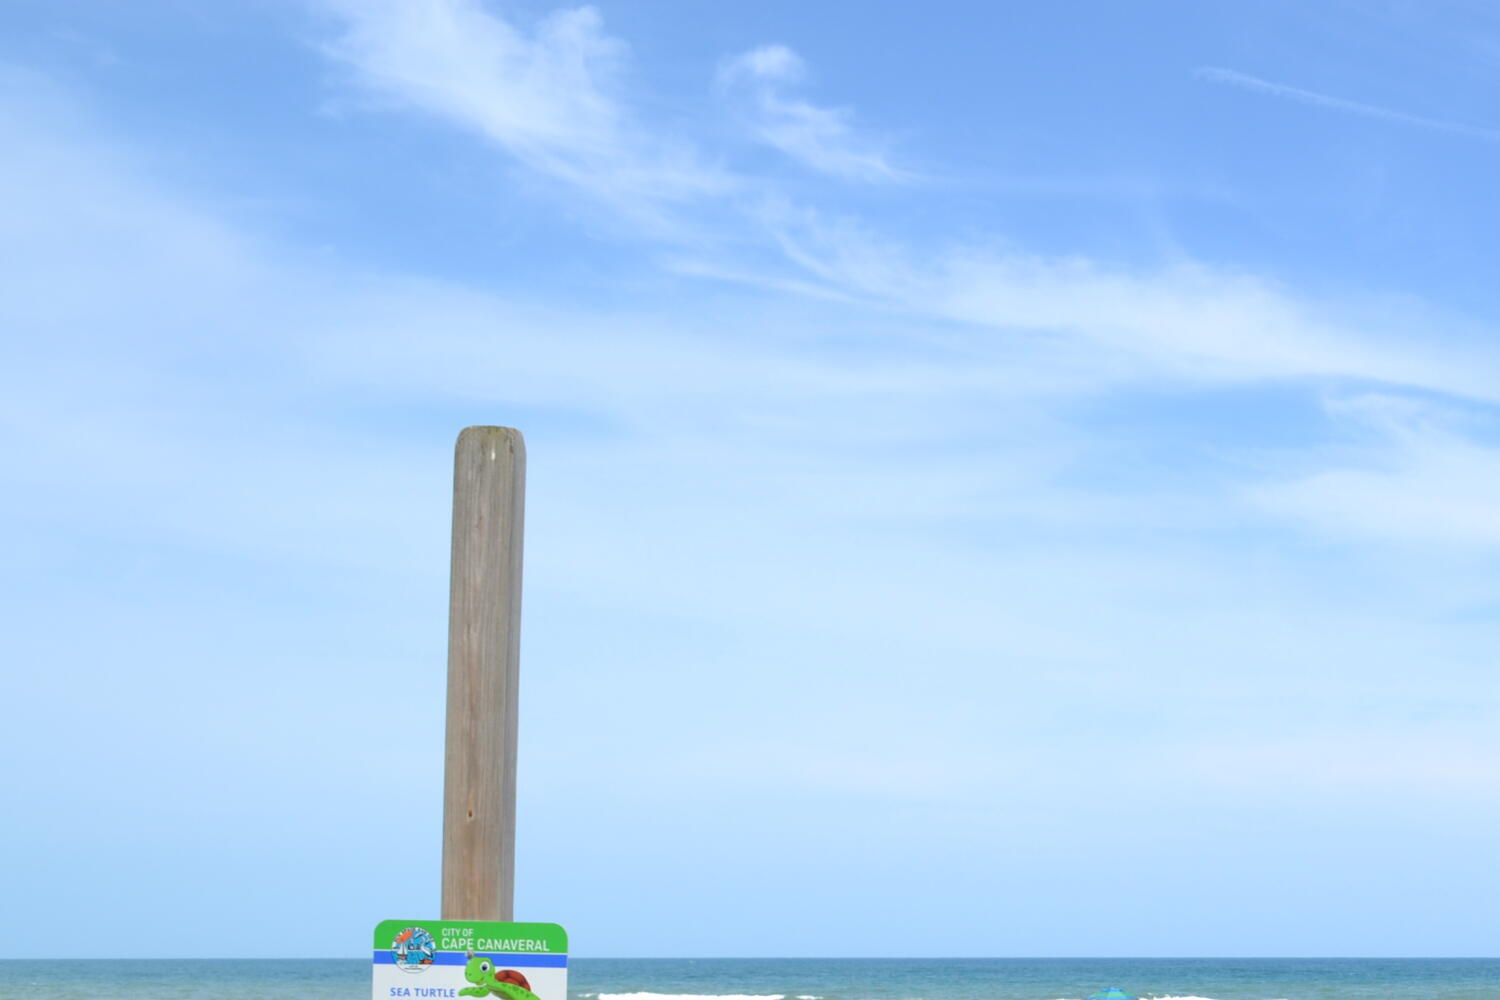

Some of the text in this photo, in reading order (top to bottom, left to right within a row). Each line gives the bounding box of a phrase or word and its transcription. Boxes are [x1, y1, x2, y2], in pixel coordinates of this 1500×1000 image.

[442, 928, 460, 937] CITY
[462, 928, 474, 937] OF
[442, 938, 550, 952] CAPE CANAVERAL
[390, 988, 456, 998] SEA TURTLE
